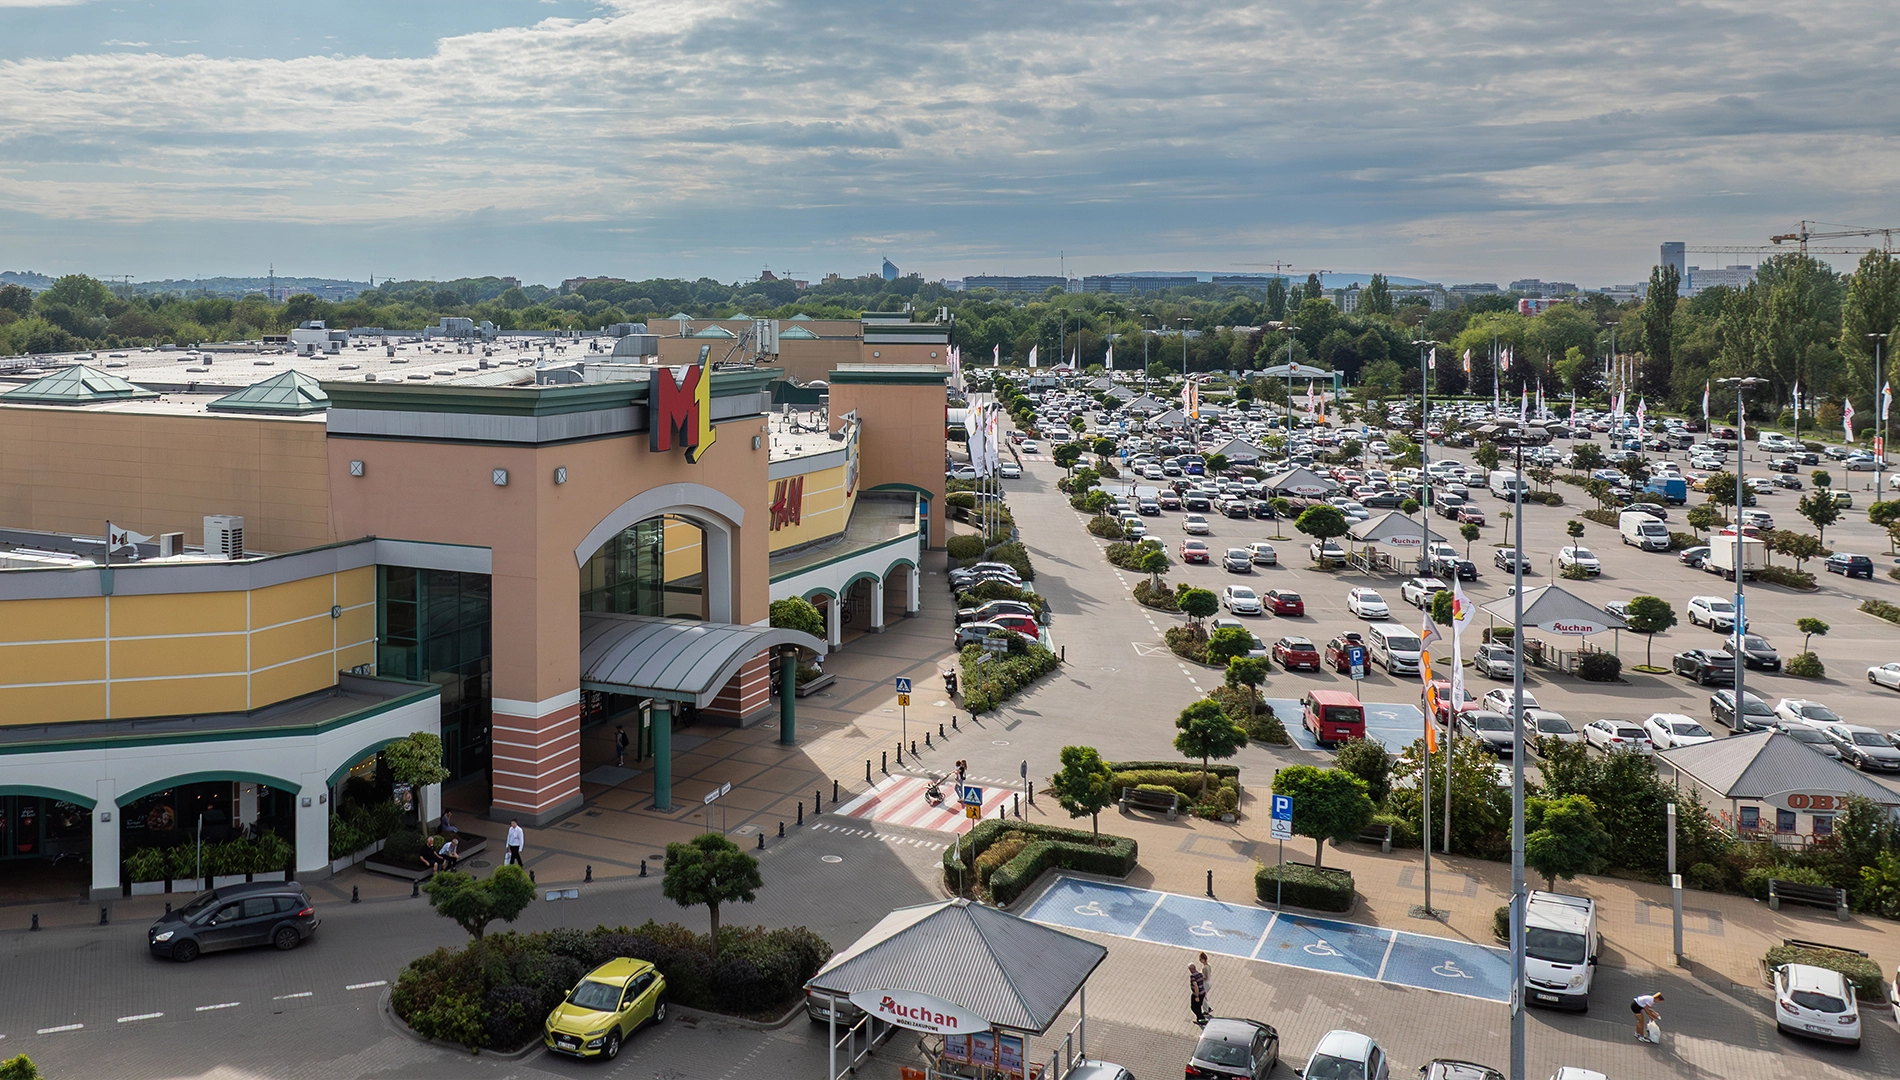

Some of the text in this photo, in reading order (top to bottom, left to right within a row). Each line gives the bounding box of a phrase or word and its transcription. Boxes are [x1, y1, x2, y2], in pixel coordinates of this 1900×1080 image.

[650, 344, 716, 464] M1
[1553, 622, 1592, 632] Auchan
[1353, 650, 1360, 661] P
[1276, 797, 1288, 812] P
[879, 995, 957, 1028] Auchan
[912, 1022, 939, 1032] ZAKUPOWE
